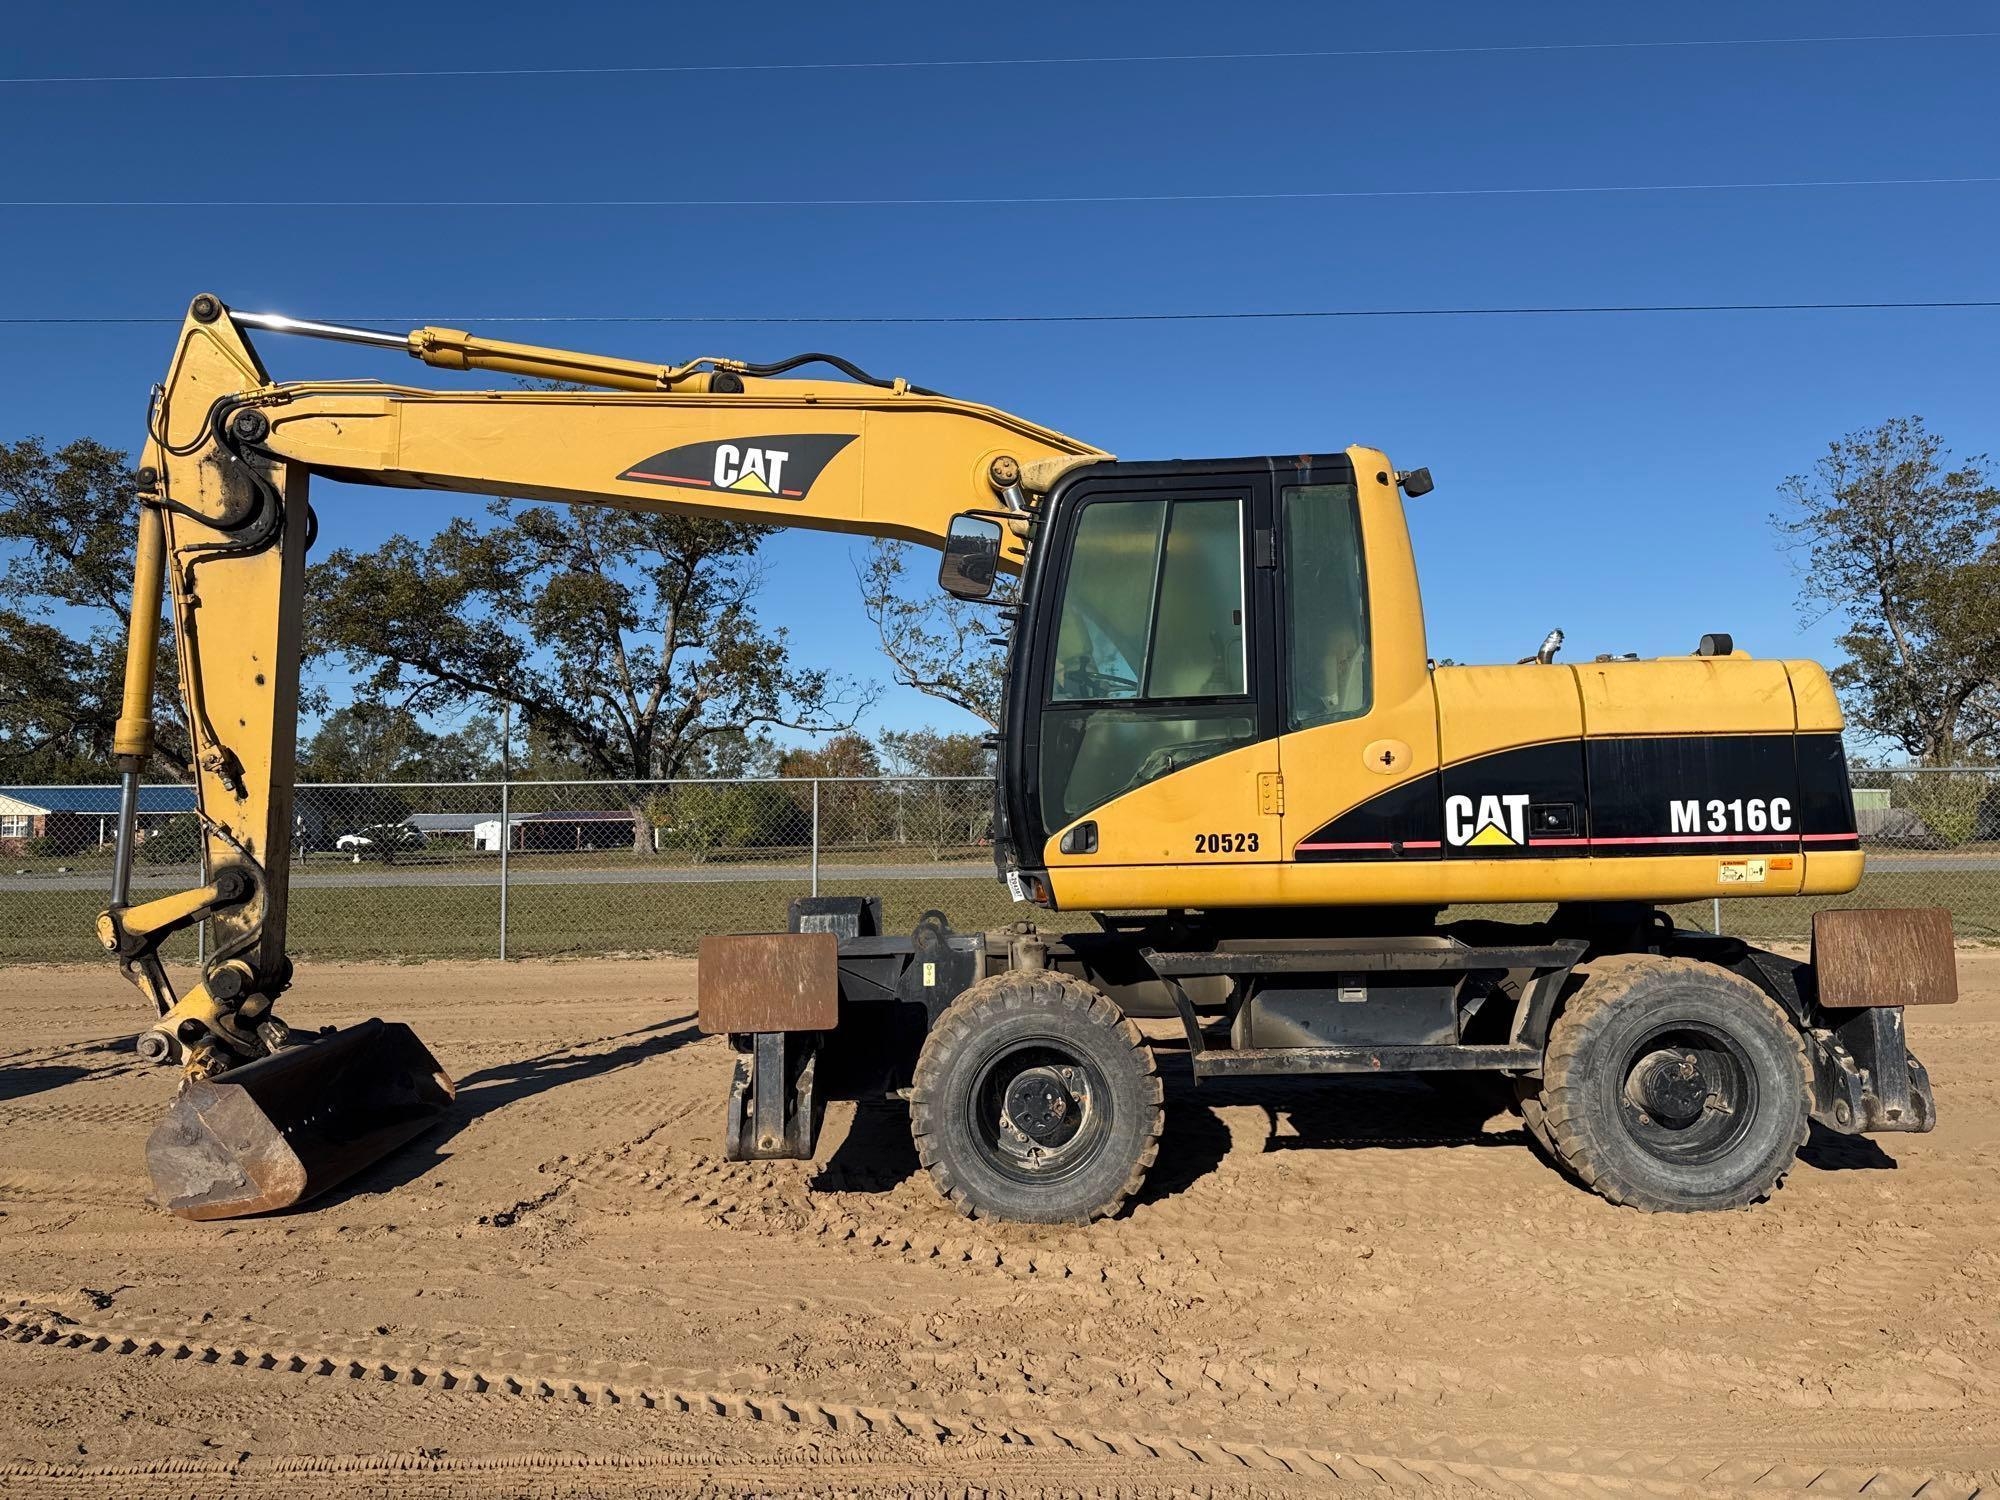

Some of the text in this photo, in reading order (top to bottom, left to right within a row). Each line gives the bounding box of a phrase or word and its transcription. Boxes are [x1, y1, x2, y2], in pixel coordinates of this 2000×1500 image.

[714, 444, 789, 494] CAT
[1195, 833, 1259, 853] 20523
[1445, 794, 1530, 846] CAT
